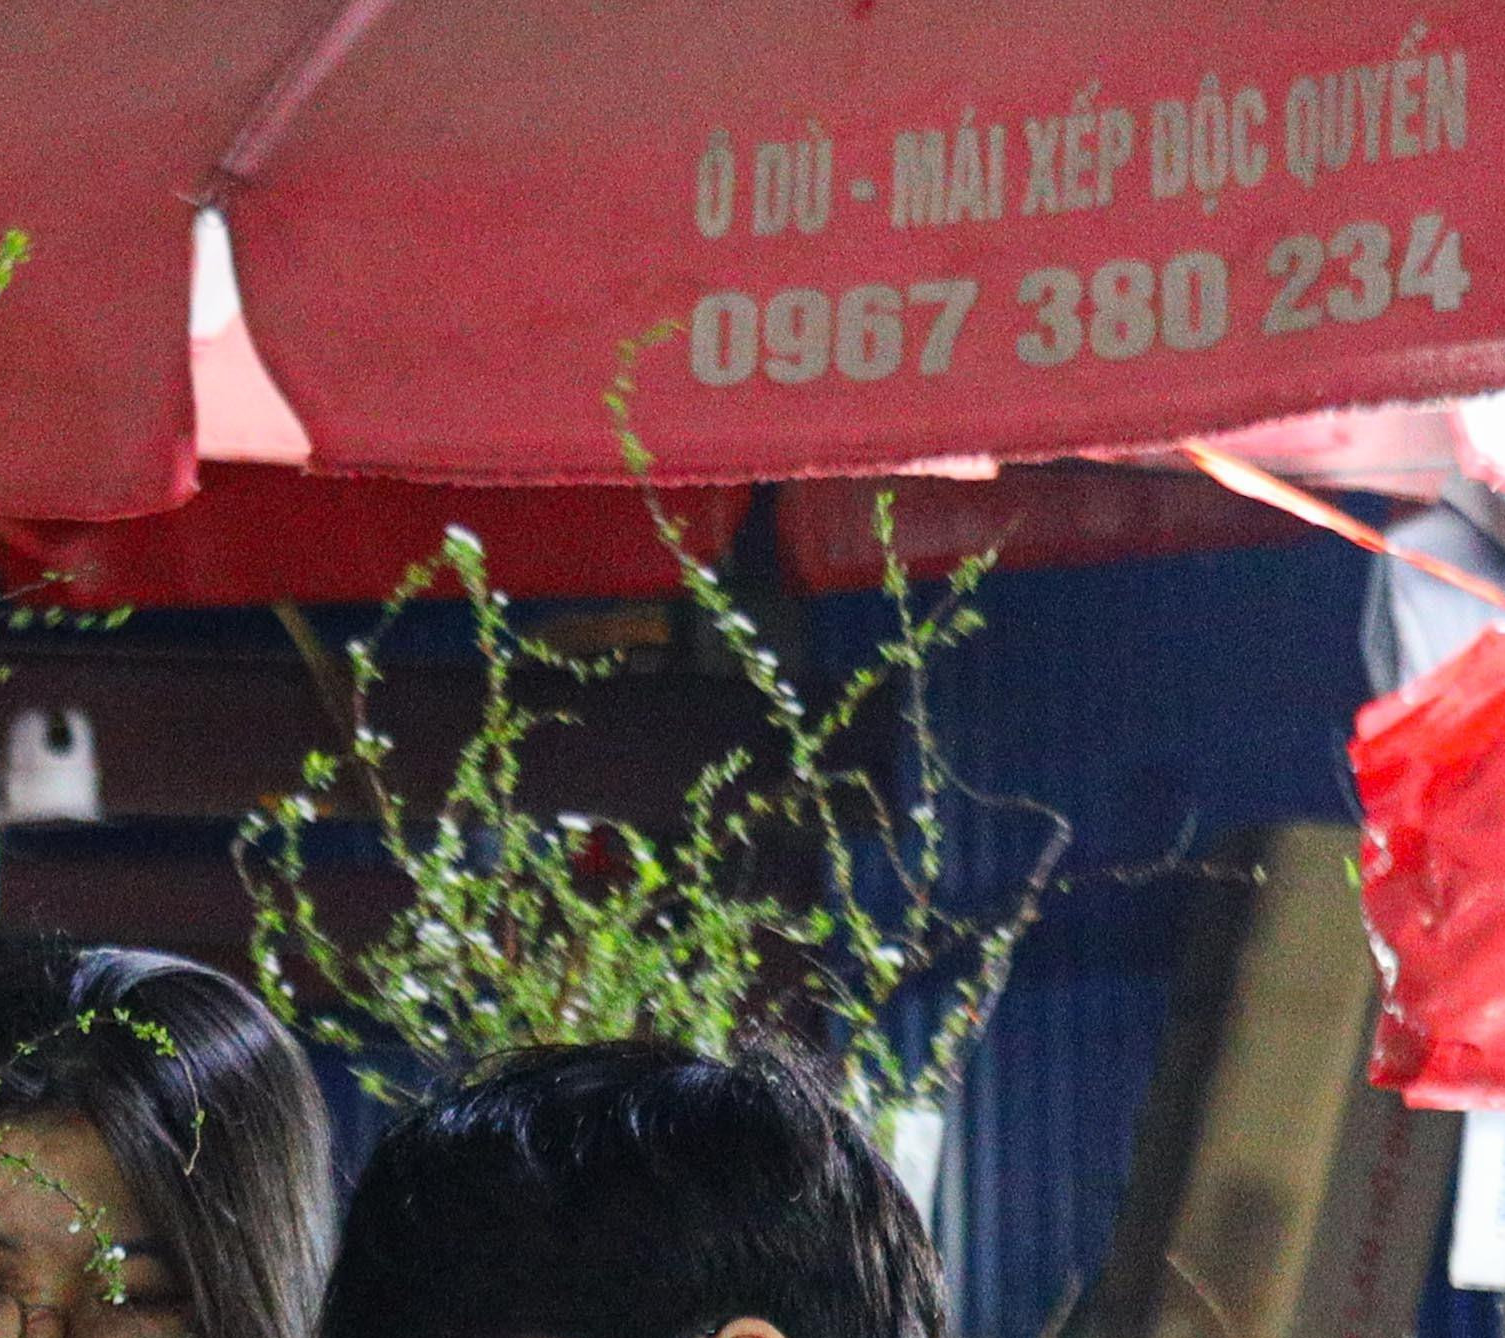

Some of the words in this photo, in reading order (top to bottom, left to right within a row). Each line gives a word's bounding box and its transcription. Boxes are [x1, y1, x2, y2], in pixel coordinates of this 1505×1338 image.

[891, 106, 1005, 229] MÁI
[1022, 80, 1134, 216] XẾP
[690, 280, 978, 387] 0967
[1014, 251, 1229, 366] 380
[1264, 214, 1472, 333] 234
